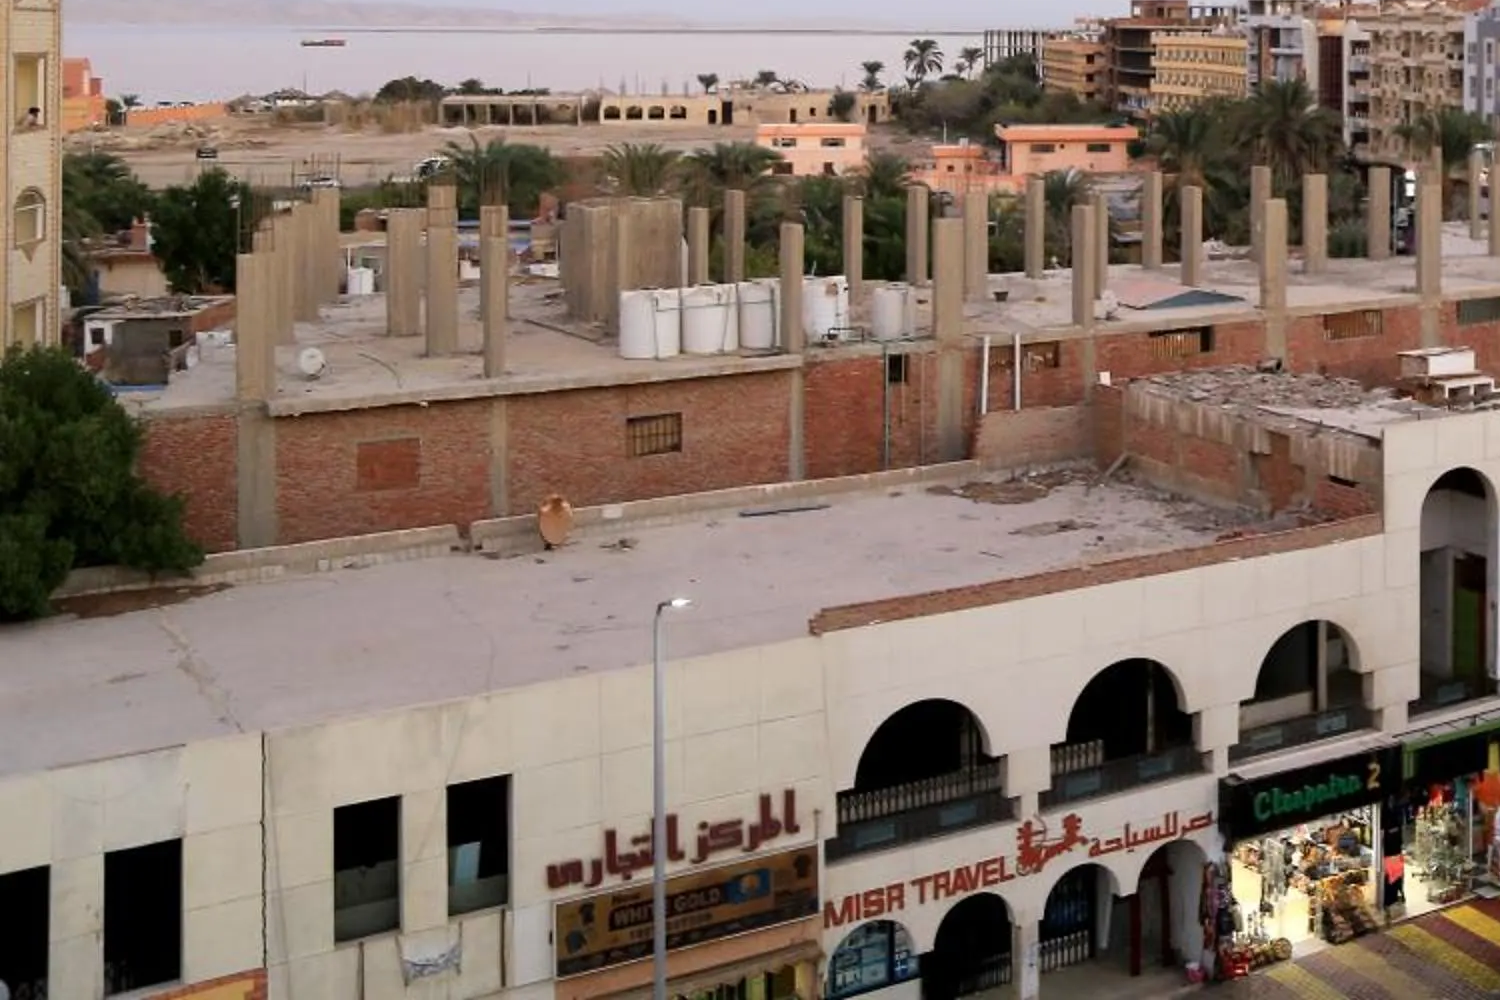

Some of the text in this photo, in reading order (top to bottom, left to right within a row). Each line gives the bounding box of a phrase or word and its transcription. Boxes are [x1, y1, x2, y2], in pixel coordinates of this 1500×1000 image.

[1366, 762, 1382, 790] 2
[824, 855, 1015, 929] MISR TRAVEL
